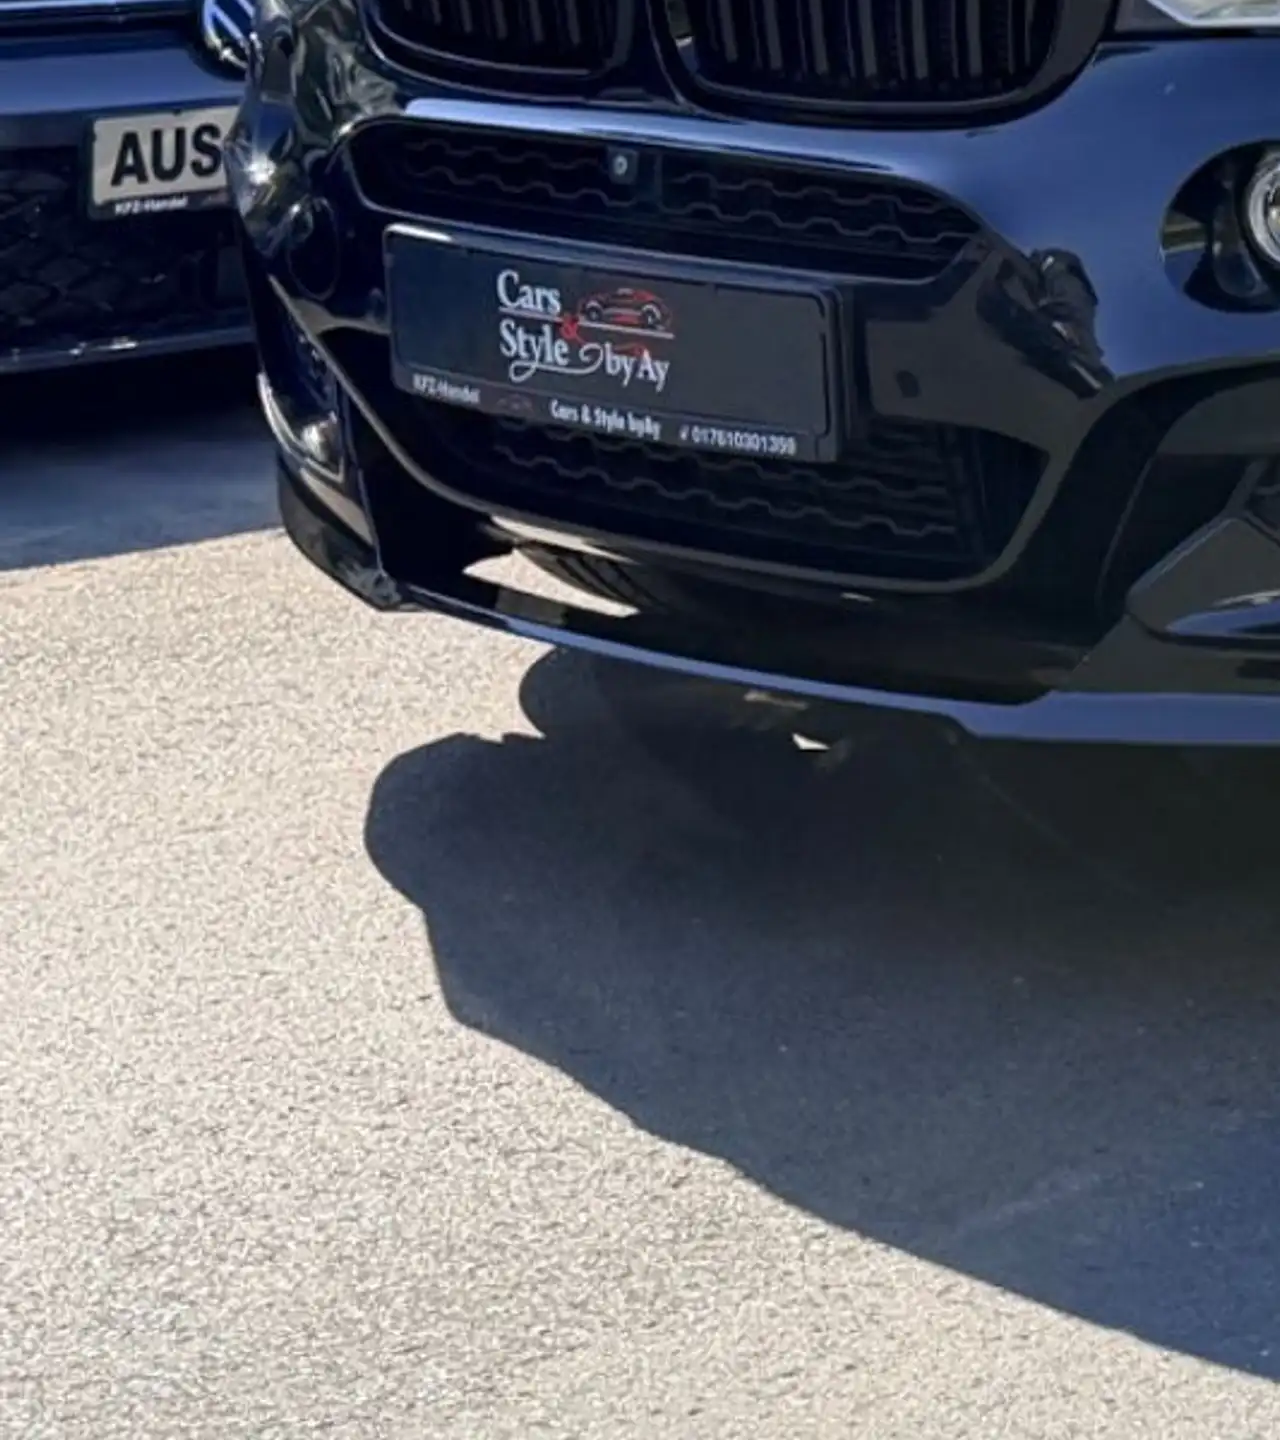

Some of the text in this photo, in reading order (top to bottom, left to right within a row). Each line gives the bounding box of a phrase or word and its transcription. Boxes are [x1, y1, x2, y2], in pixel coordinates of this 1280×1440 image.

[110, 123, 222, 187] AUS
[496, 269, 561, 313] Cars
[499, 318, 585, 380] Style
